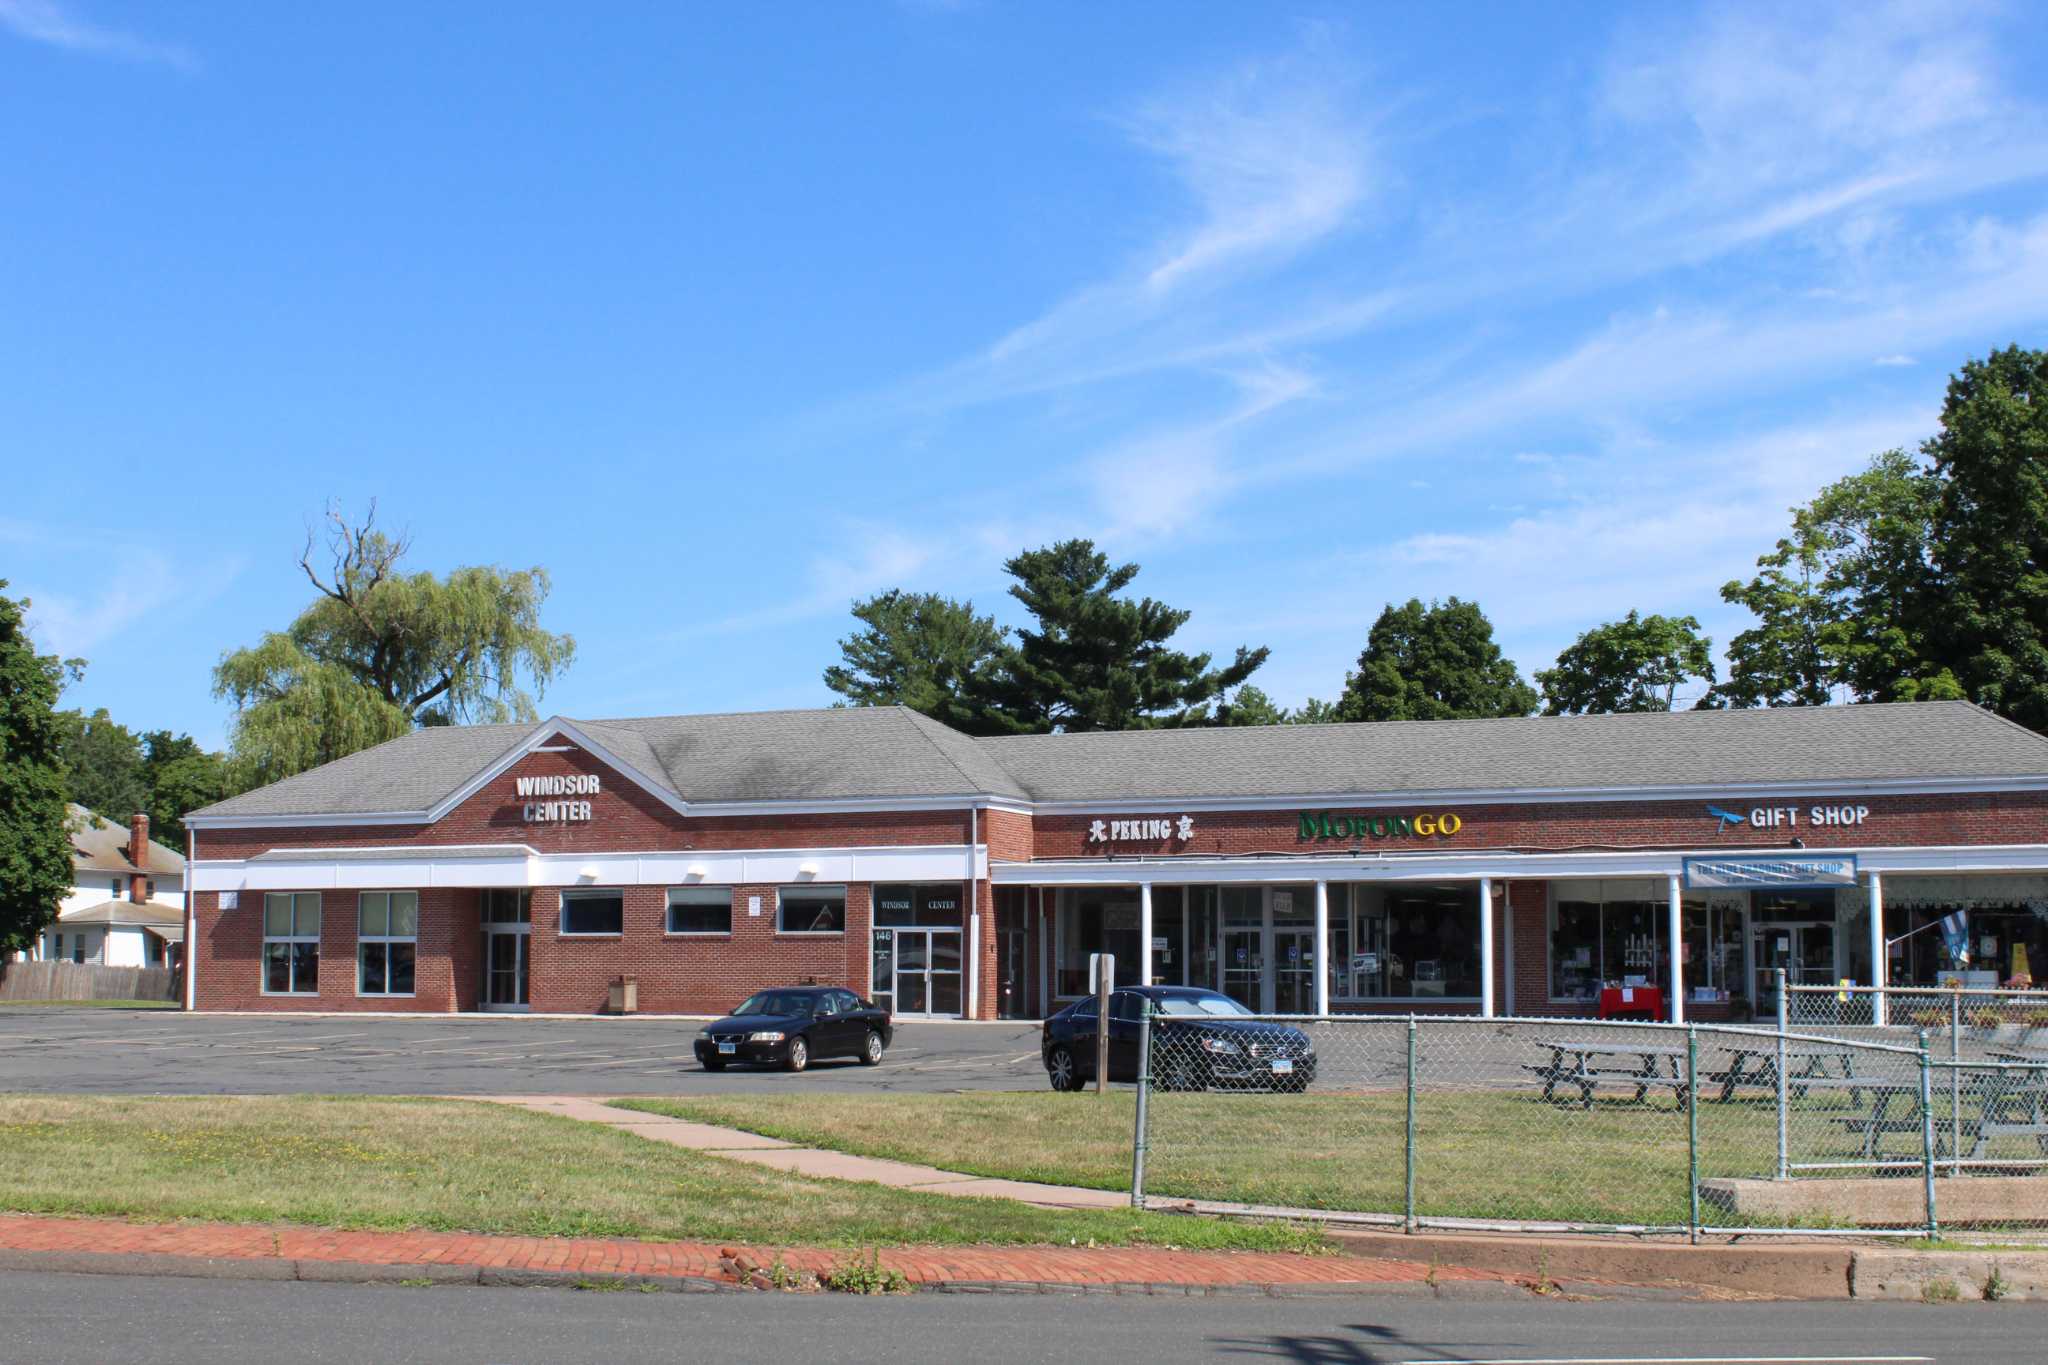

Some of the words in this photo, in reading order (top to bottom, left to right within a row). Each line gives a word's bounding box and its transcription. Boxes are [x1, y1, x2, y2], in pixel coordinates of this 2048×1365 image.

[516, 775, 600, 796] WINDSOR
[523, 801, 592, 821] CENTER
[1751, 807, 1798, 827] GIFT
[1811, 806, 1869, 825] SHOP
[1111, 820, 1171, 840] PEKING
[1818, 863, 1843, 873] SHOP
[928, 900, 956, 909] CENTER
